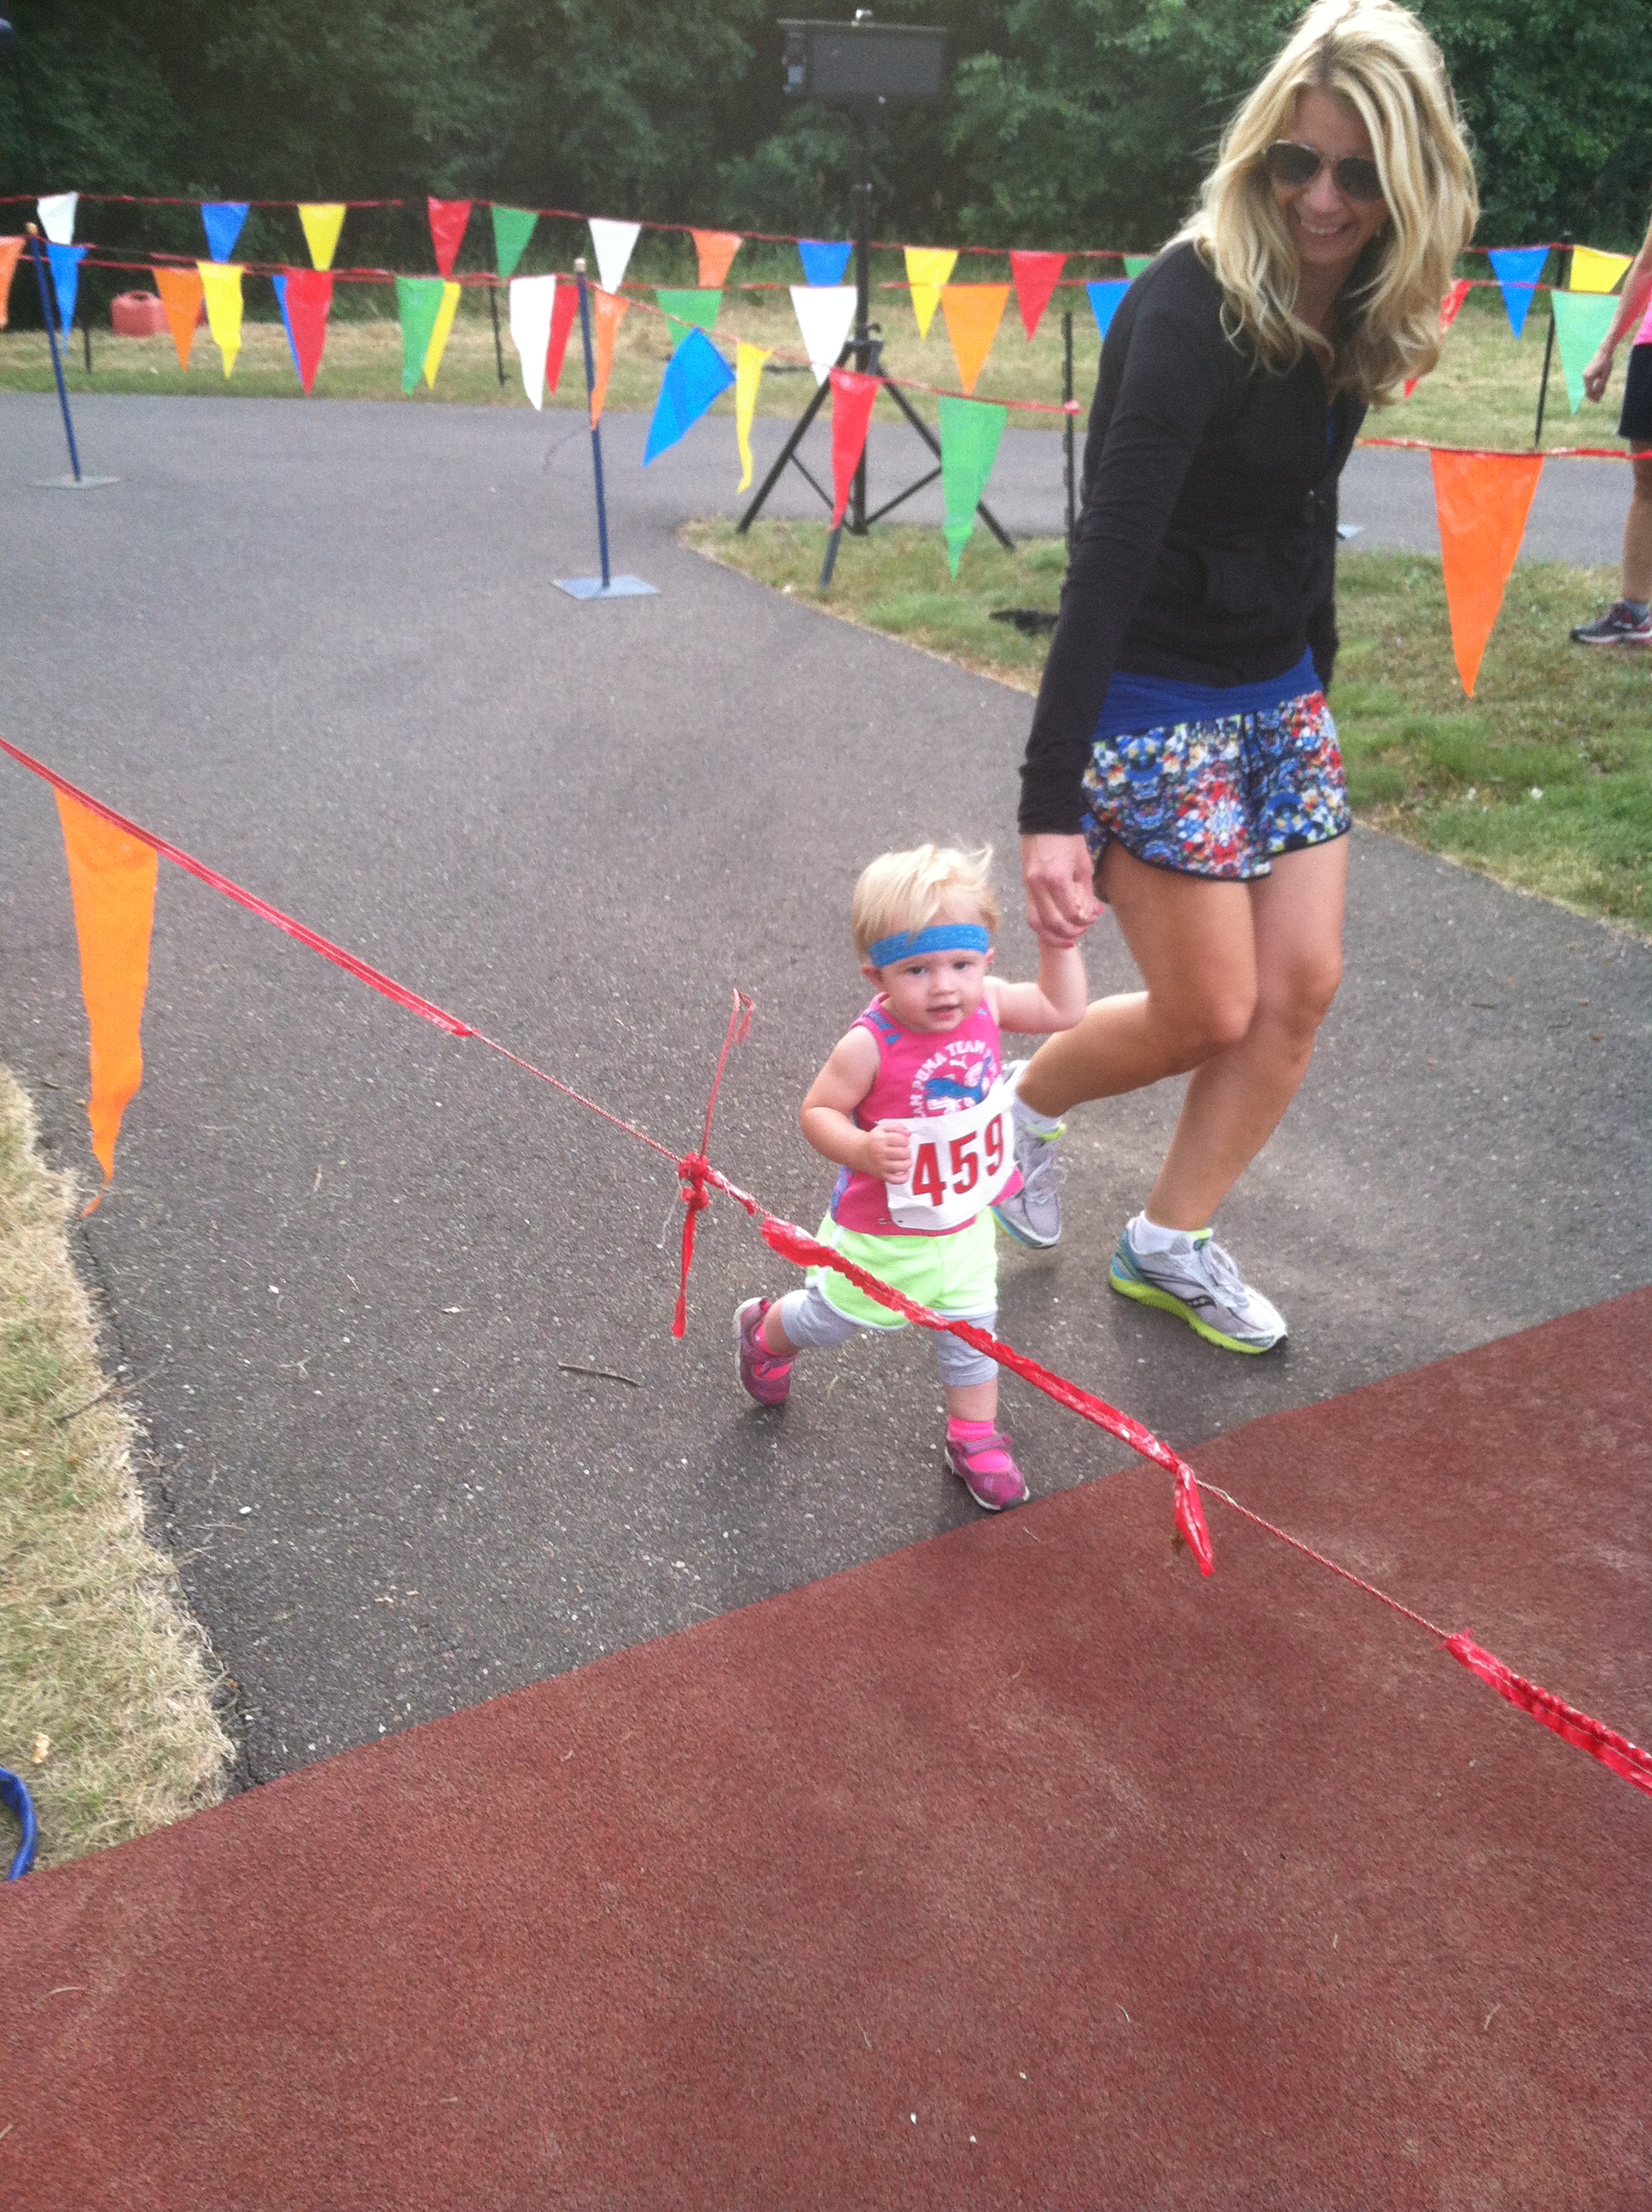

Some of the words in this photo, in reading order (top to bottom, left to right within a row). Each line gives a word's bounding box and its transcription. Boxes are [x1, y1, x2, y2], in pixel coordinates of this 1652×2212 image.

[911, 1051, 947, 1090] PUMA
[945, 1039, 986, 1057] TEAM
[911, 1112, 1003, 1207] 459
